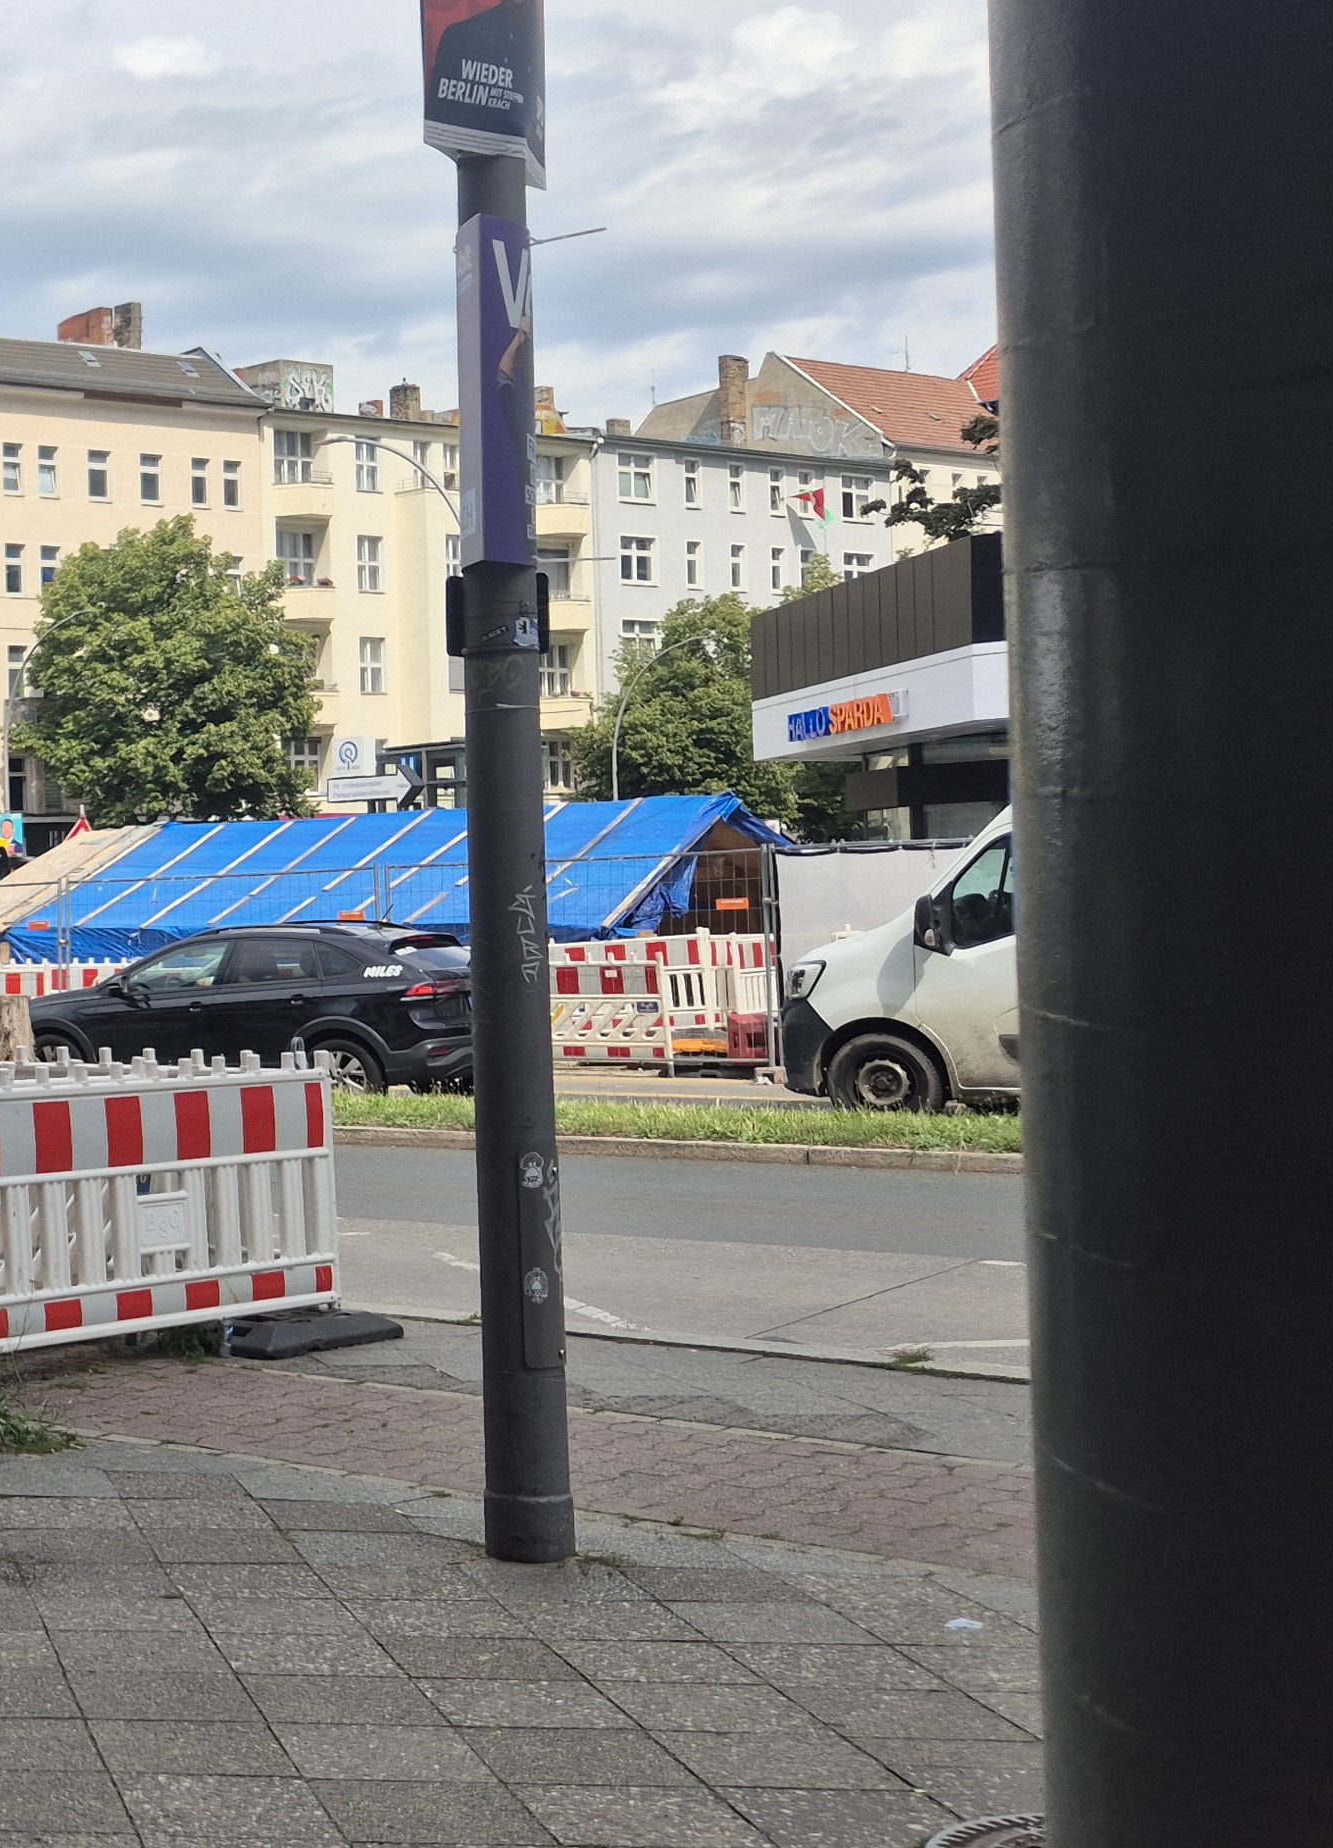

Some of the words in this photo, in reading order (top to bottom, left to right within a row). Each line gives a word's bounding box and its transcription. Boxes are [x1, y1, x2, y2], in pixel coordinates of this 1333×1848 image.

[461, 58, 514, 89] WIEDER
[437, 77, 489, 107] BERLIN
[487, 97, 510, 110] KRACH
[489, 86, 502, 98] MIT
[788, 706, 826, 742] HALLO
[828, 699, 884, 735] SPARDA
[363, 965, 403, 978] MILES
